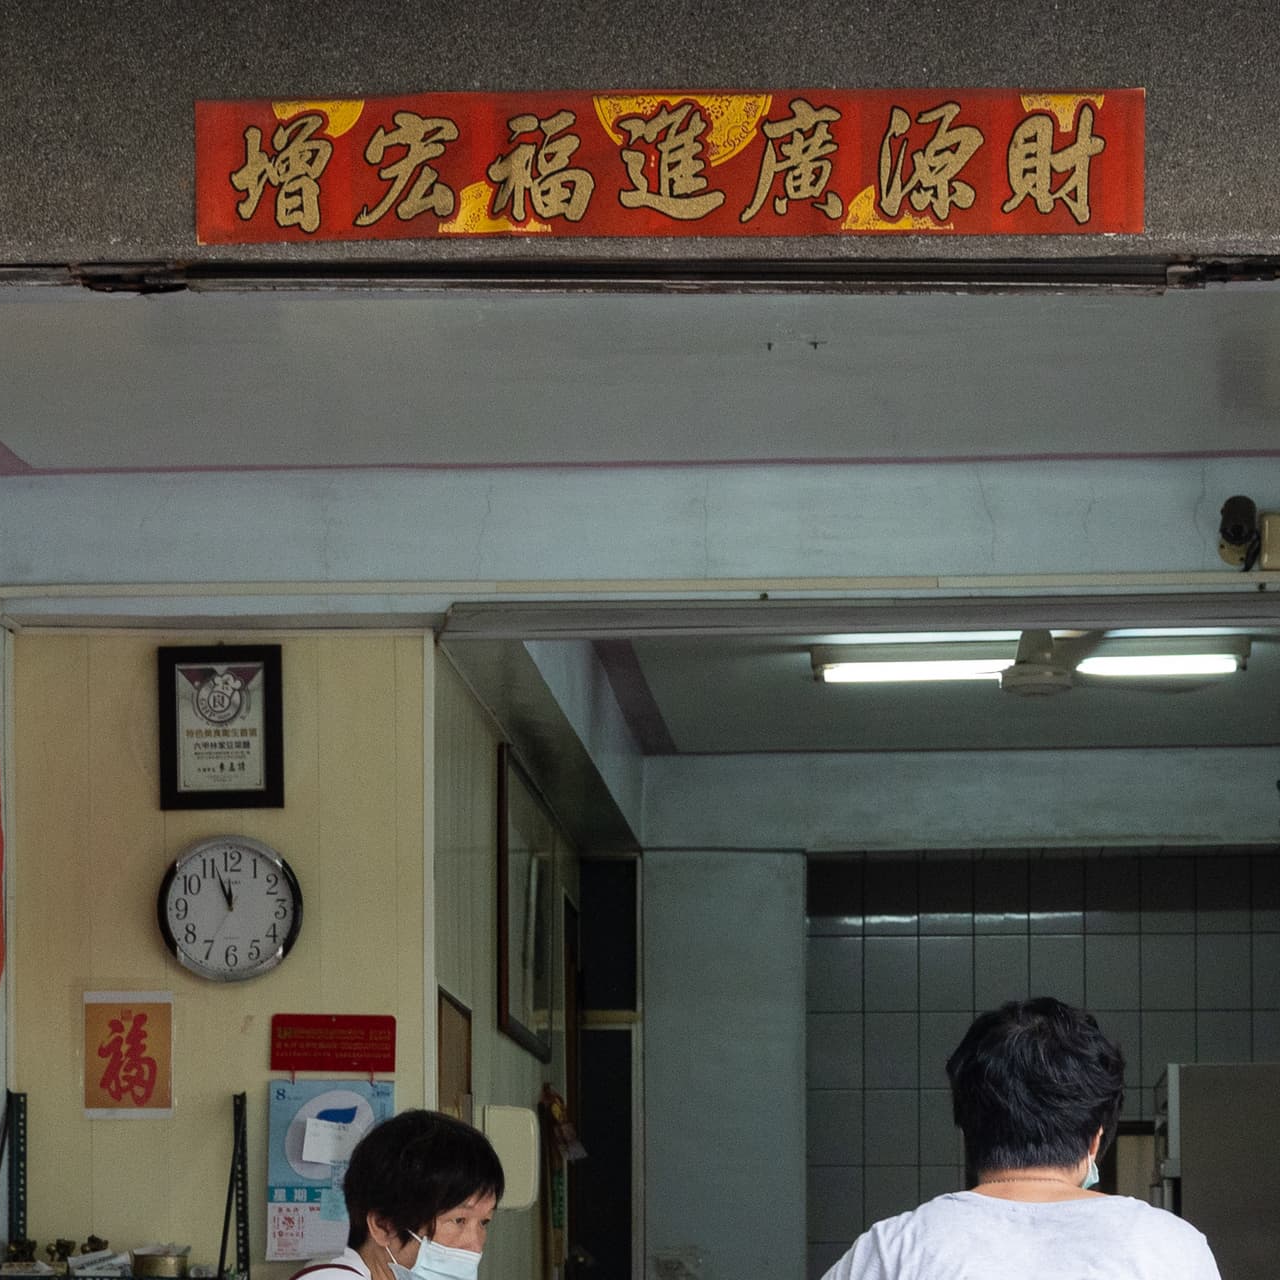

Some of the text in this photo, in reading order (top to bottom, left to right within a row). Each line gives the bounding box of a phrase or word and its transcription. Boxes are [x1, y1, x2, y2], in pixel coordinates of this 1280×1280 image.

[201, 858, 216, 879] 11
[223, 851, 242, 872] 12
[183, 873, 201, 896] 10
[266, 873, 278, 895] 2
[175, 898, 188, 920] 9
[274, 899, 287, 919] 3
[184, 923, 197, 944] 8
[265, 922, 278, 943] 4
[203, 940, 214, 960] 7
[224, 945, 238, 968] 6
[247, 940, 260, 960] 5
[98, 1013, 158, 1107] 福
[276, 1088, 286, 1100] 8
